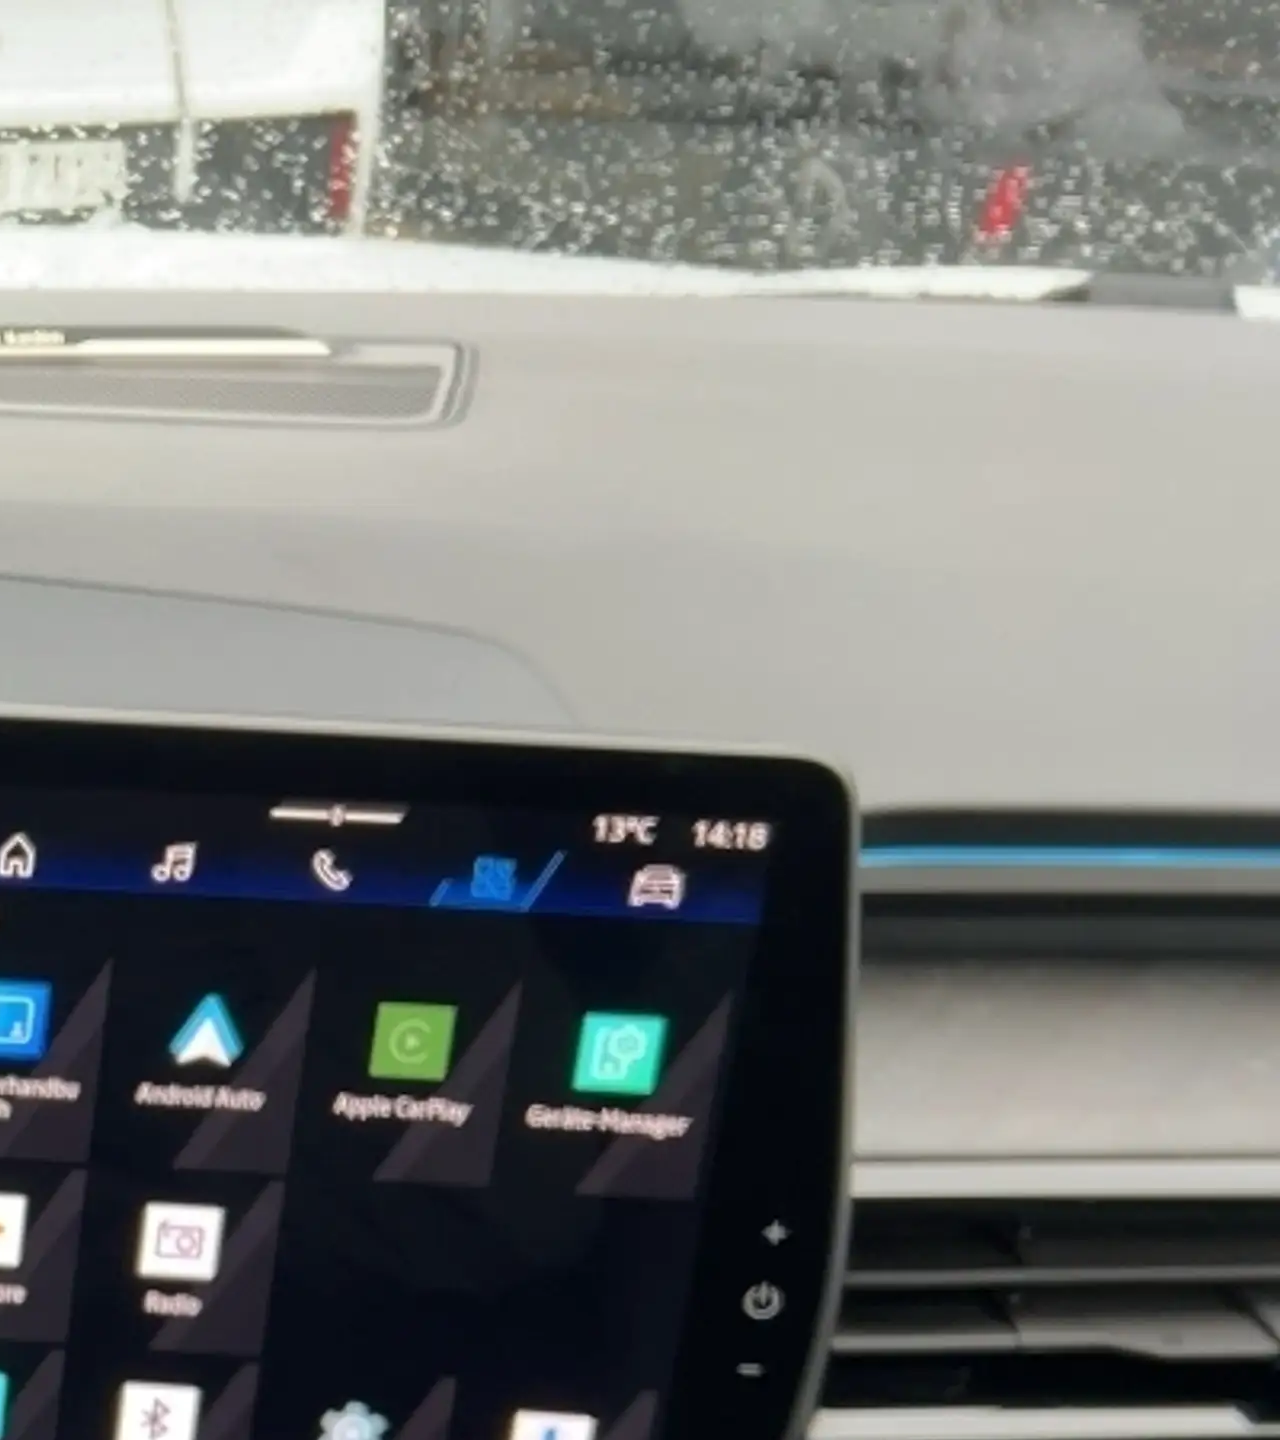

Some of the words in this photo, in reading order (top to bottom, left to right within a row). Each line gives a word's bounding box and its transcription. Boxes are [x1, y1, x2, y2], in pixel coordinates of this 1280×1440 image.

[135, 1080, 212, 1109] Android
[213, 1084, 266, 1112] Auto
[332, 1092, 392, 1121] Apple
[394, 1093, 474, 1128] CarPlay
